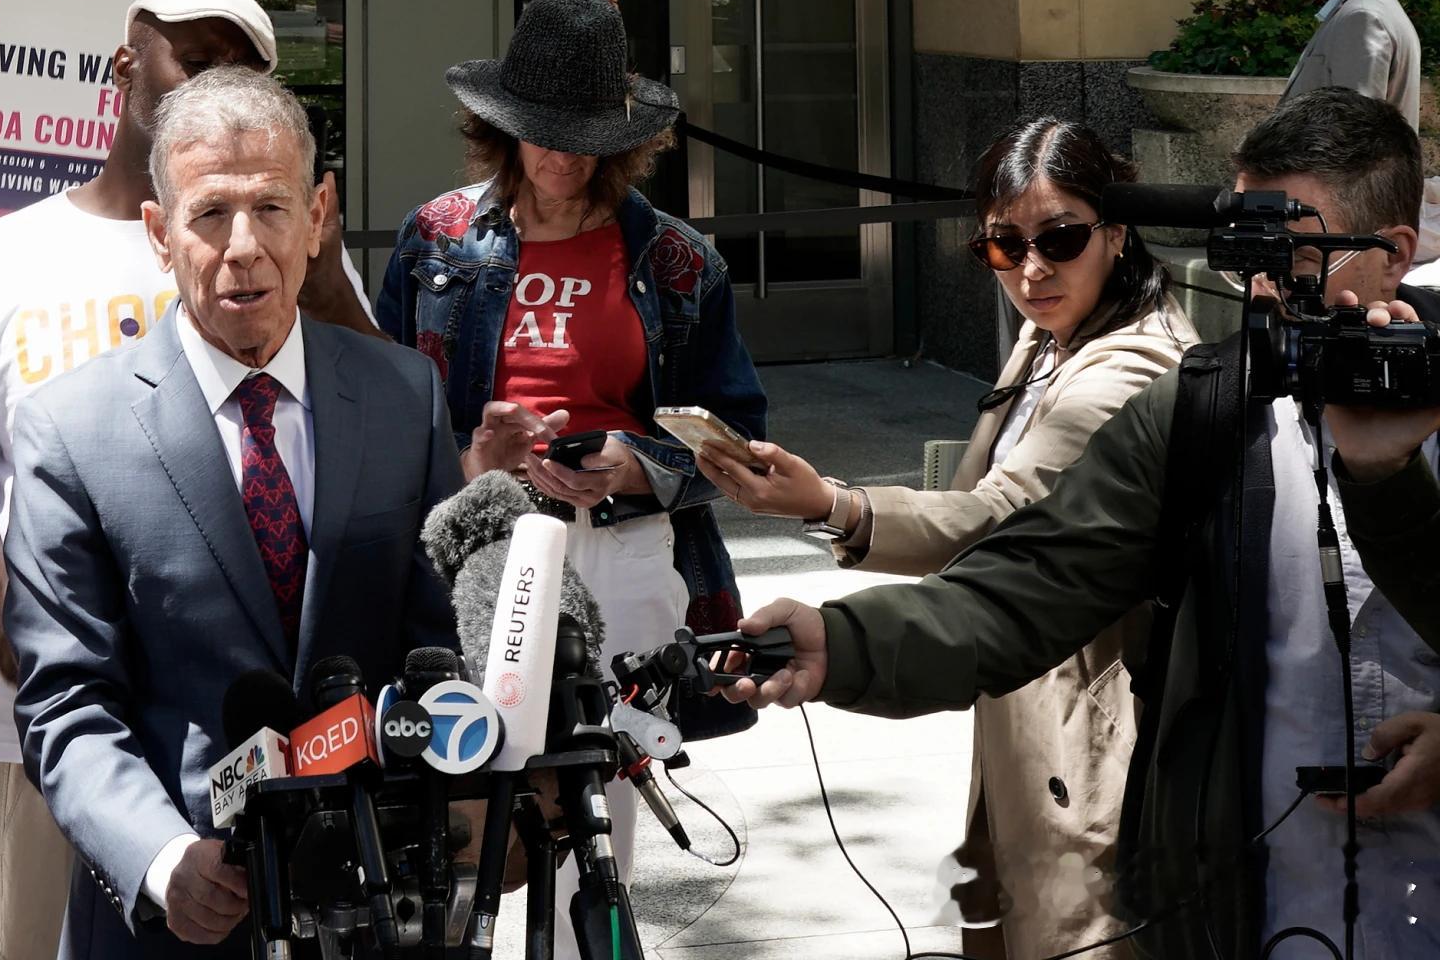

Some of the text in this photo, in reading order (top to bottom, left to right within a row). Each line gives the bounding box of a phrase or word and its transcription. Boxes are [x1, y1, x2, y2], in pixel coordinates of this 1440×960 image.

[79, 53, 115, 85] WA
[33, 114, 115, 151] COUN
[68, 162, 87, 175] ONE
[49, 178, 80, 195] WA
[514, 272, 592, 307] OP
[504, 311, 573, 349] AI
[504, 566, 535, 662] REUTERS
[296, 717, 358, 770] KQED
[384, 719, 433, 739] abc
[212, 755, 245, 799] NBC
[214, 790, 235, 815] BAY
